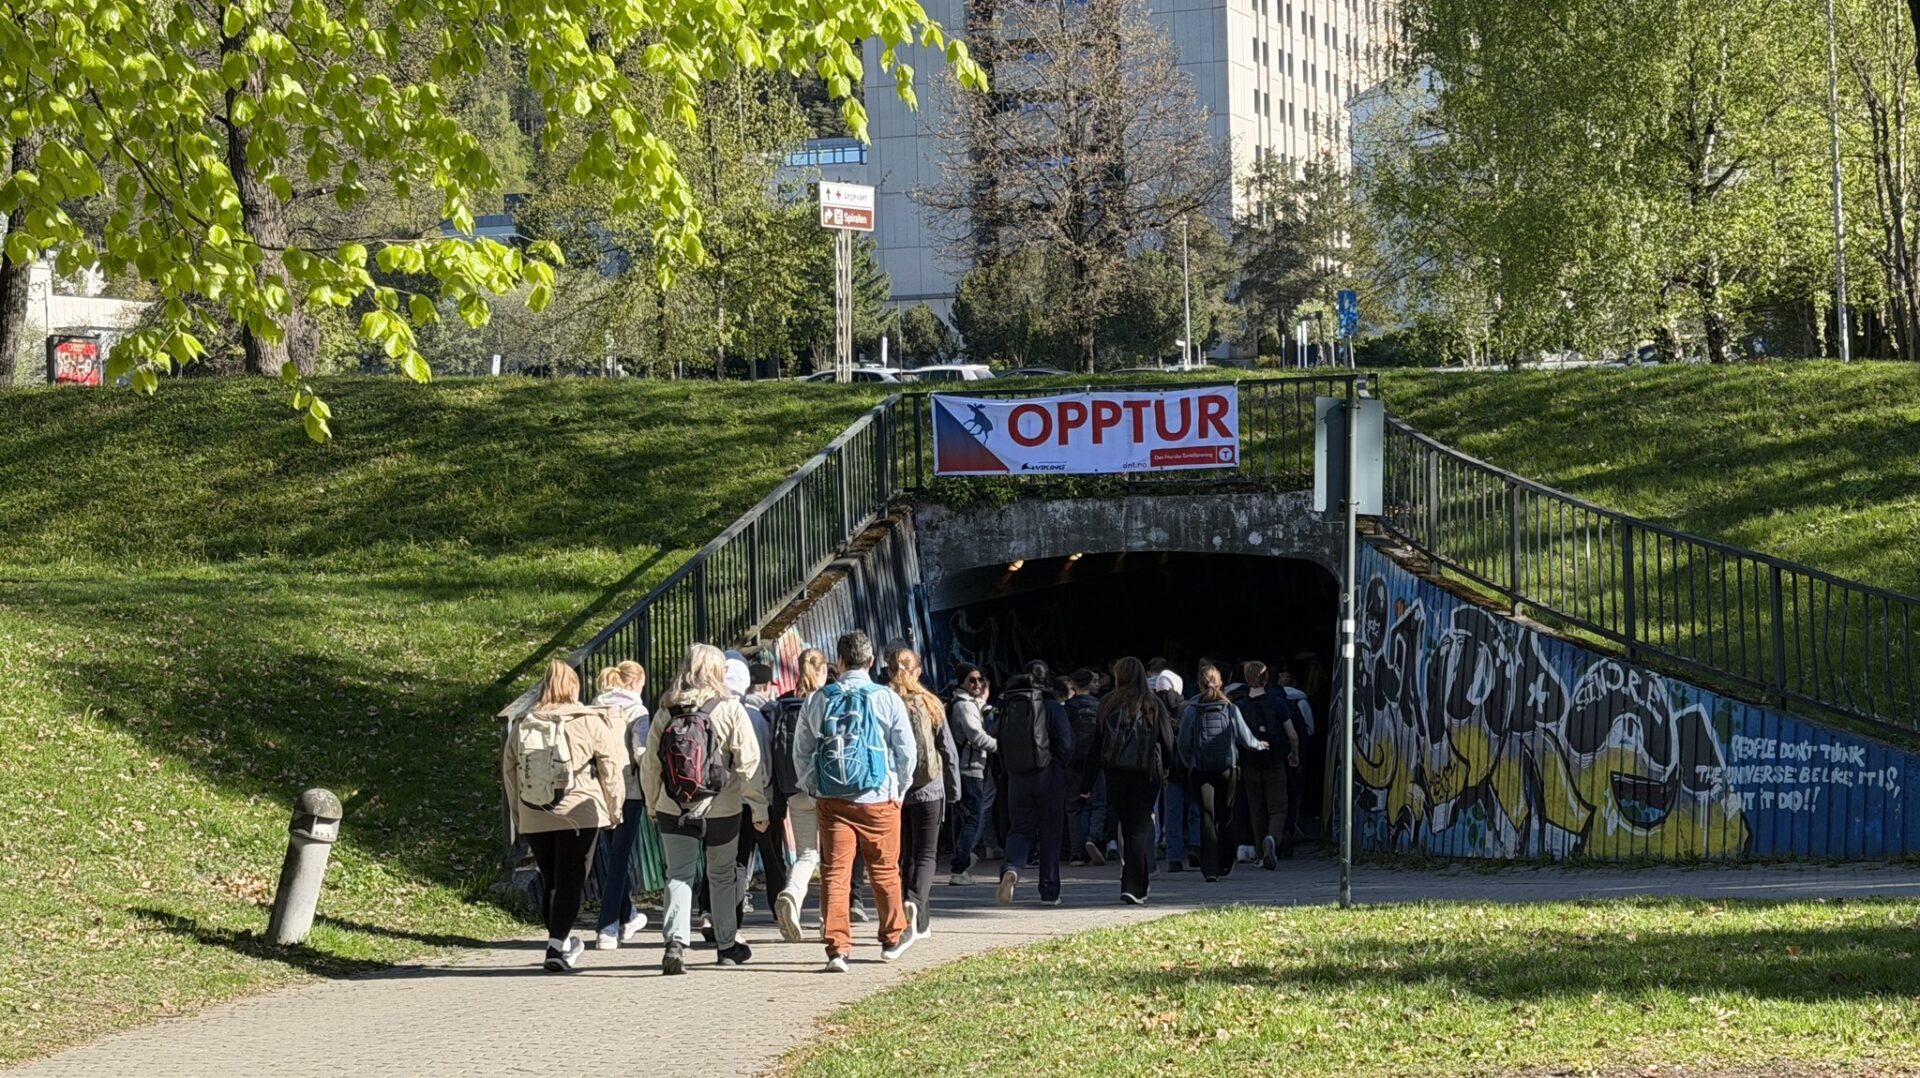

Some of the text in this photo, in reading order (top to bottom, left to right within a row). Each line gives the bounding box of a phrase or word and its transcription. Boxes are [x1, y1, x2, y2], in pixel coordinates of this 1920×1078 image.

[844, 212, 867, 225] Spiralen
[1007, 394, 1234, 447] OPPTUR
[1123, 461, 1147, 469] dnt.no
[1731, 735, 1777, 762] PEOPLE
[1820, 742, 1866, 767] THINK
[1695, 765, 1723, 784] THE
[1725, 764, 1797, 784] UNIVERSE
[1799, 766, 1821, 784] BE
[1760, 787, 1775, 810] IT
